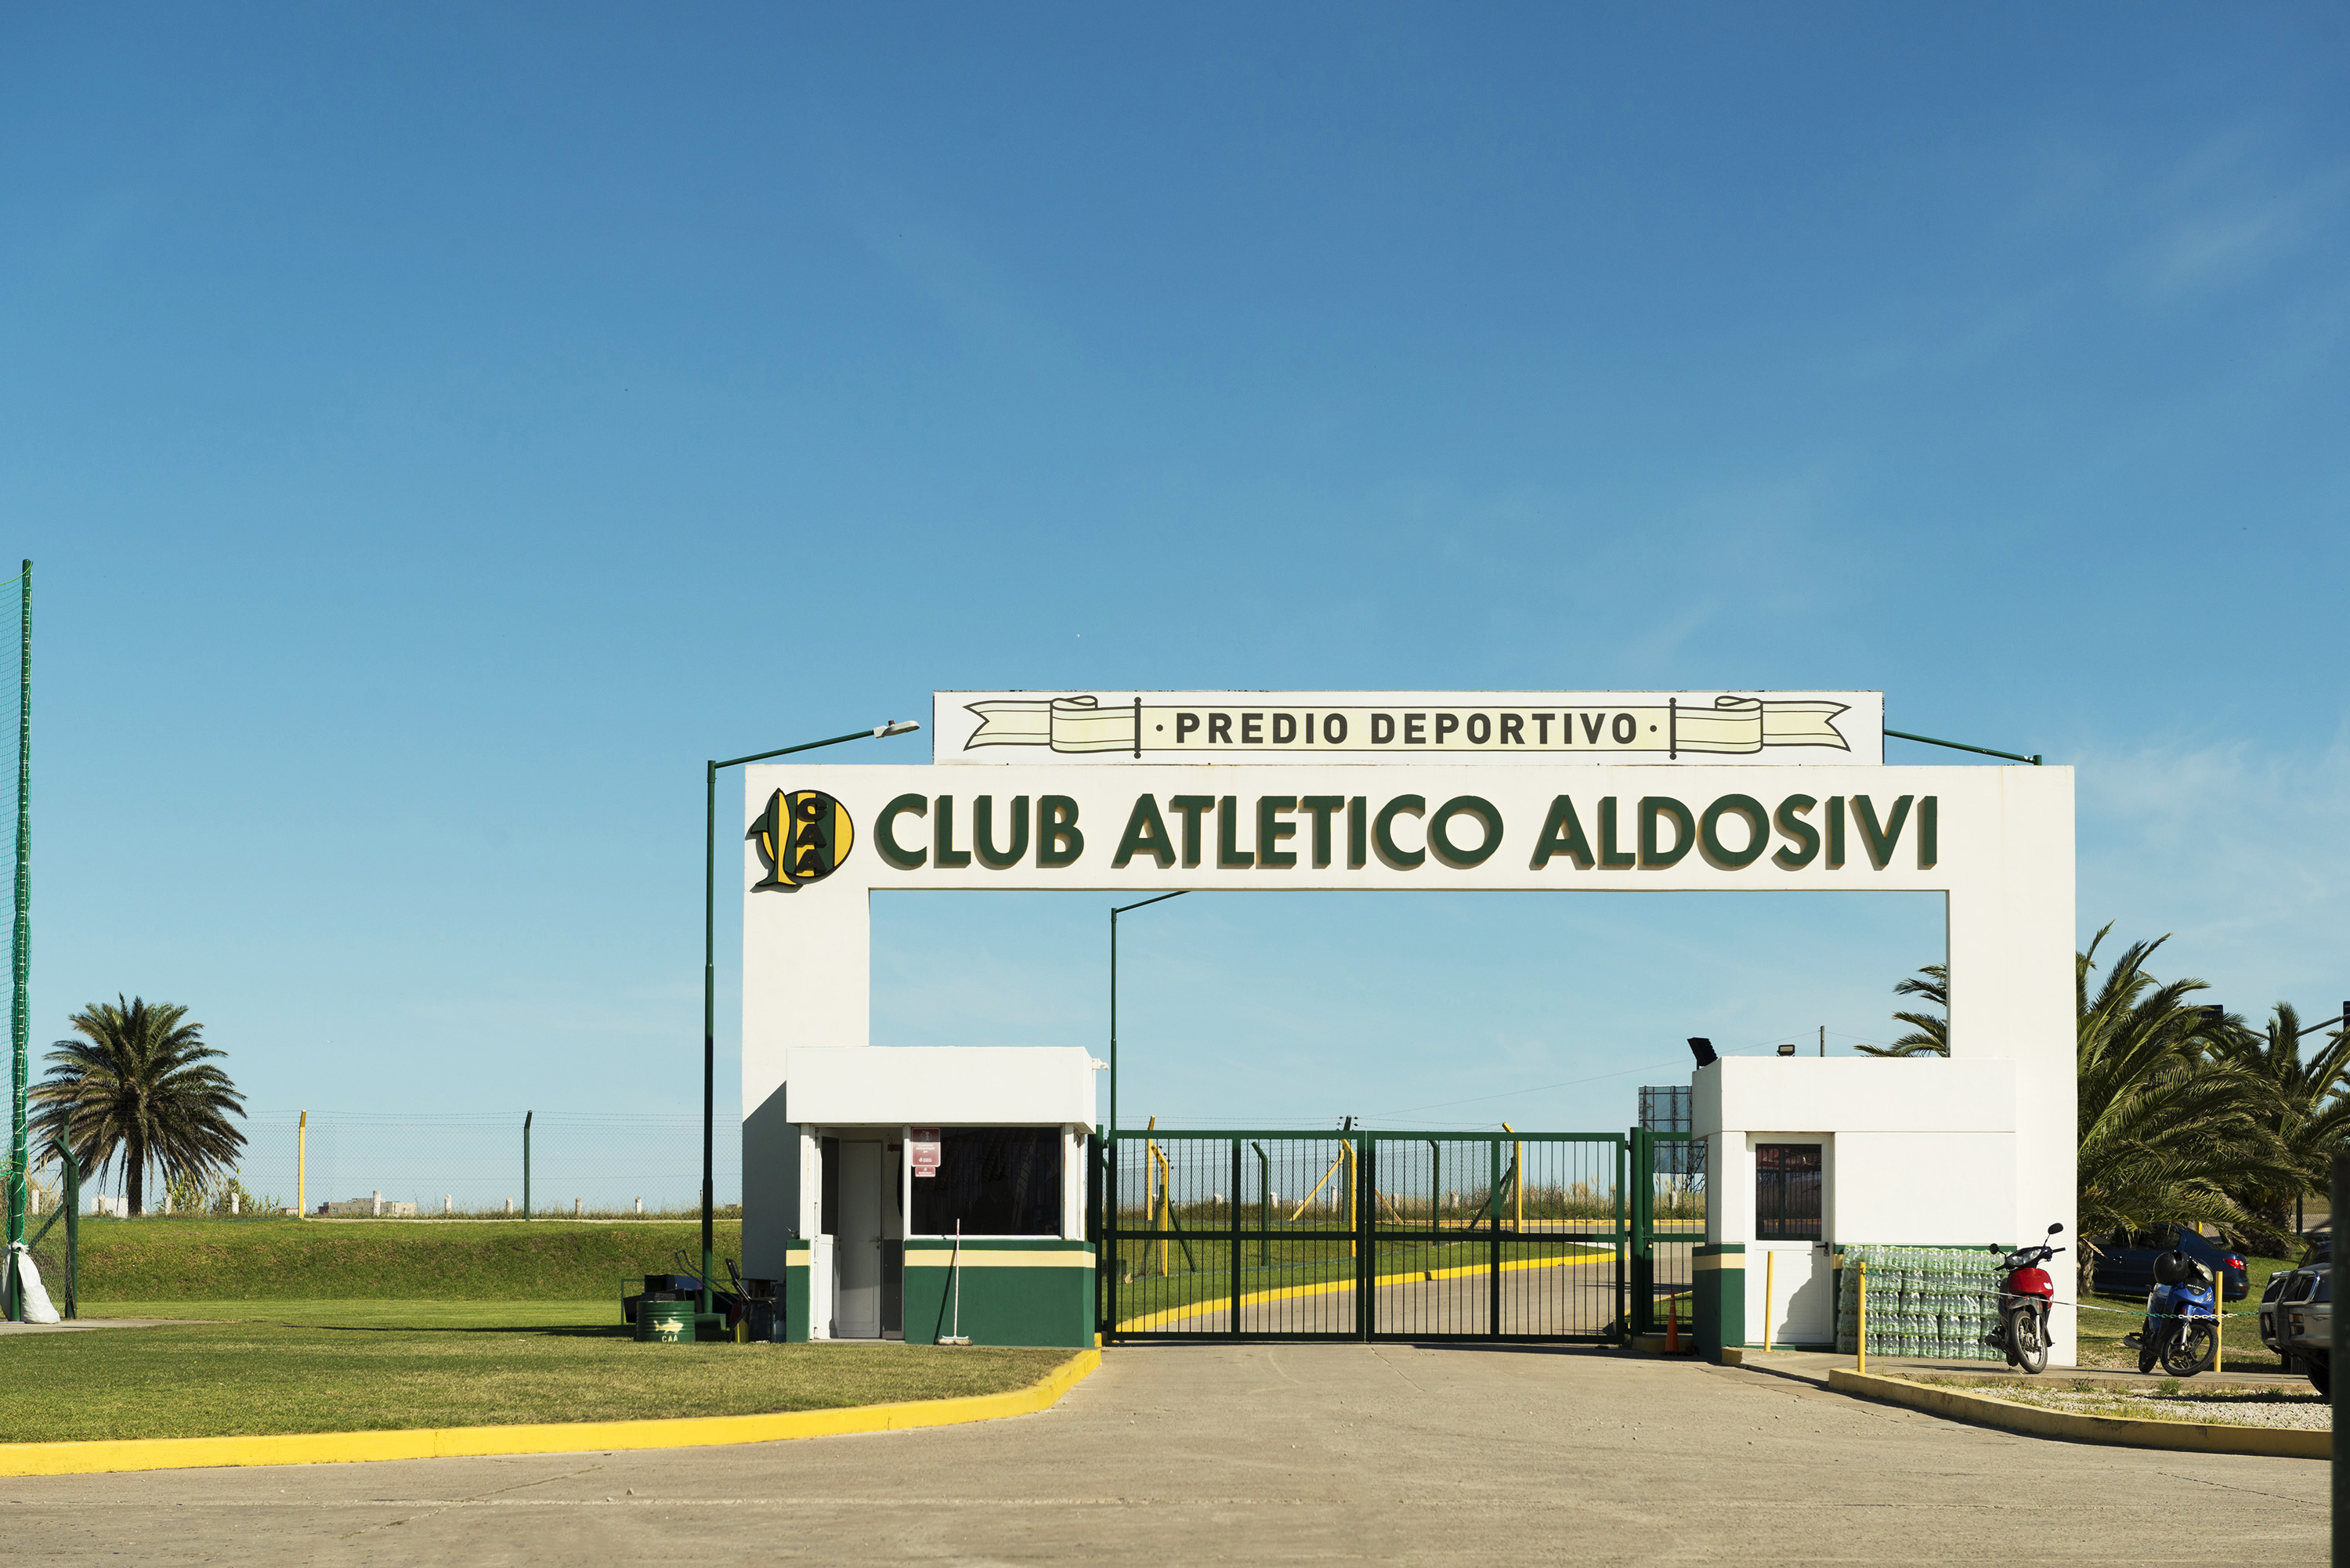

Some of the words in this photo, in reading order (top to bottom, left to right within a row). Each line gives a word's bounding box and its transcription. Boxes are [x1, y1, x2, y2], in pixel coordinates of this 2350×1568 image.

[1177, 713, 1348, 745] PREDIO
[1371, 713, 1636, 745] DEPORTIVO
[794, 797, 827, 873] CAA
[876, 793, 1085, 869] CLUB
[1113, 793, 1503, 869] ATLETICO
[1532, 793, 1938, 869] ALDOSIVI
[661, 1334, 678, 1342] CAA
